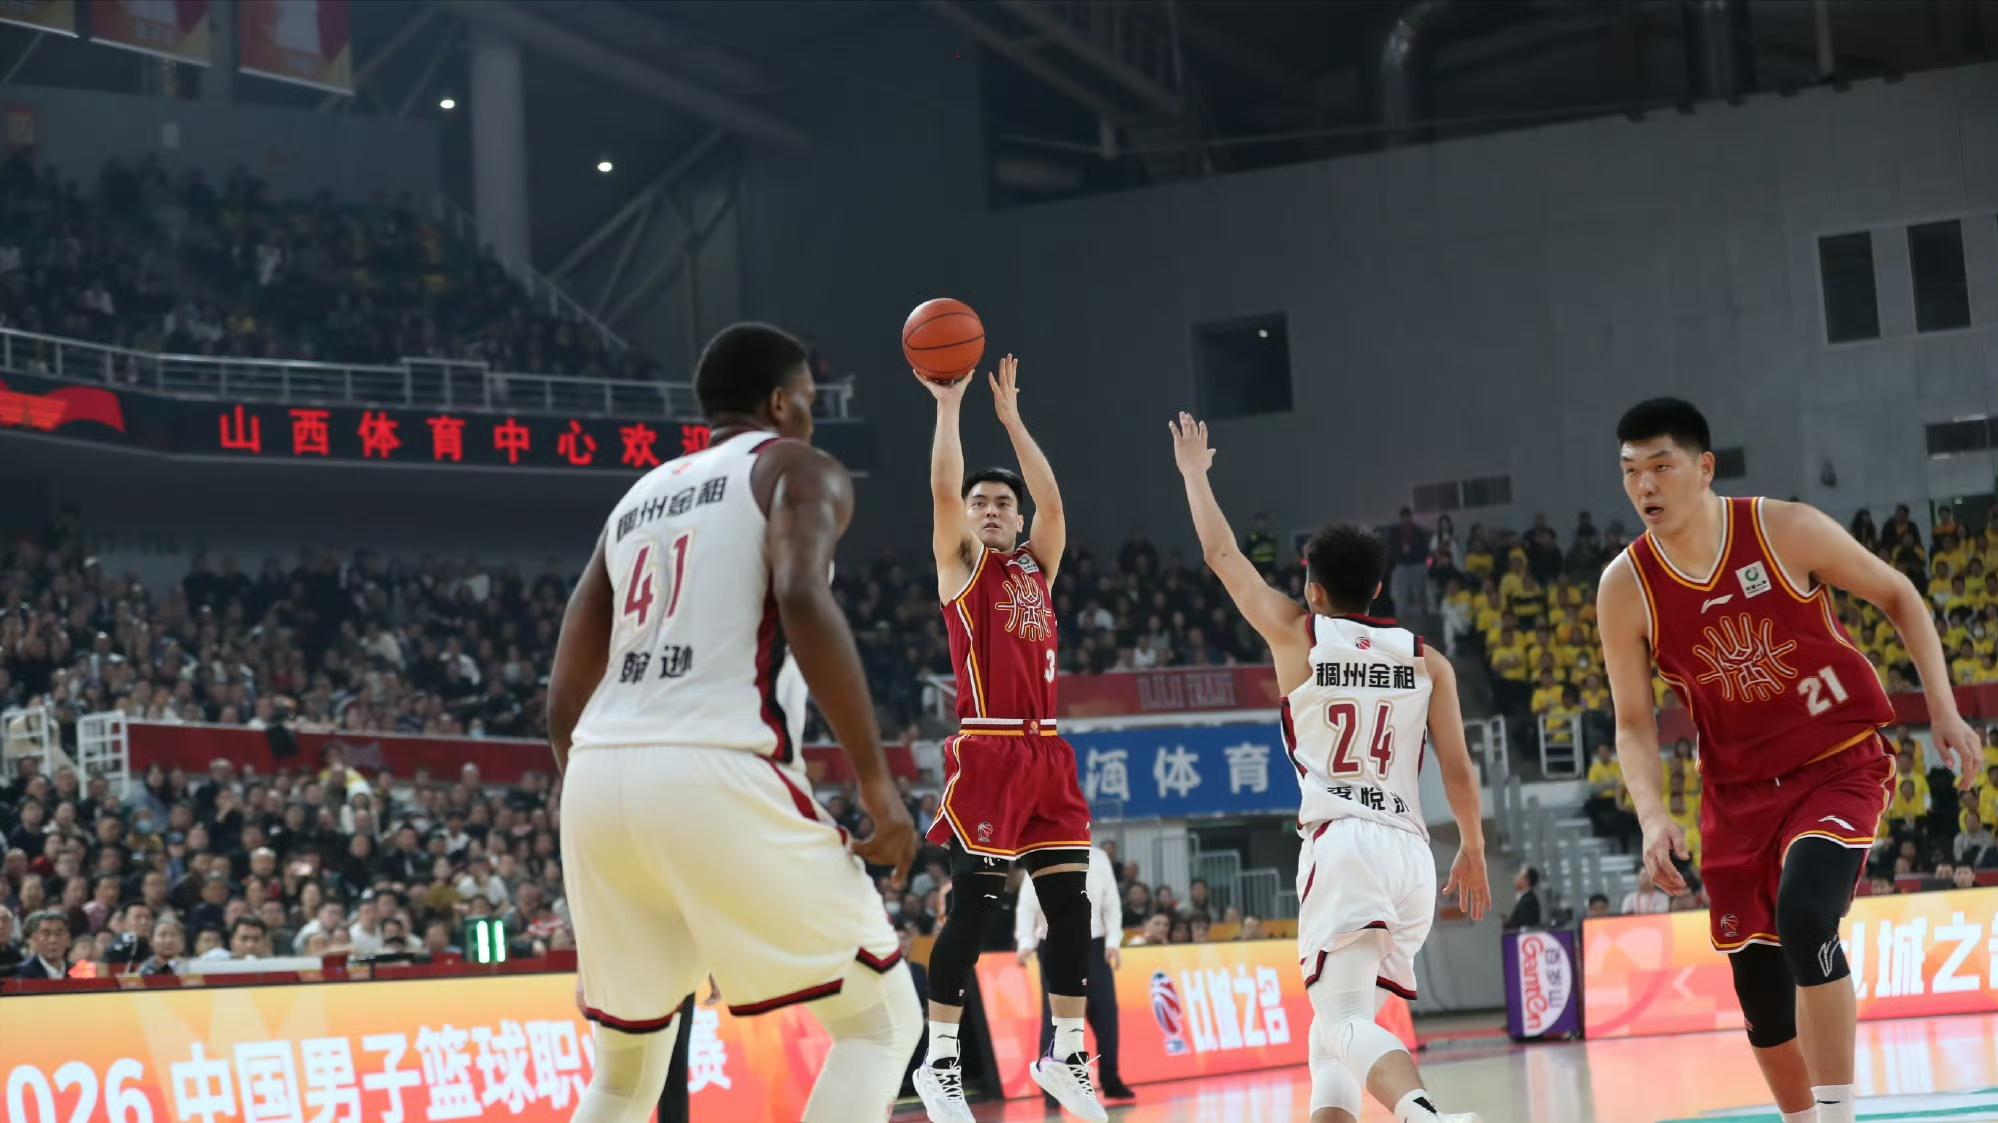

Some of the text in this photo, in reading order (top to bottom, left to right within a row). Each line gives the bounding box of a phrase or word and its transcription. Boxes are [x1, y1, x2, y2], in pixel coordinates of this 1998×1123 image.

[622, 532, 690, 627] 41
[1044, 649, 1056, 684] 3
[1316, 662, 1416, 690] 稠州金租
[1797, 665, 1849, 717] 21
[1326, 700, 1397, 777] 24
